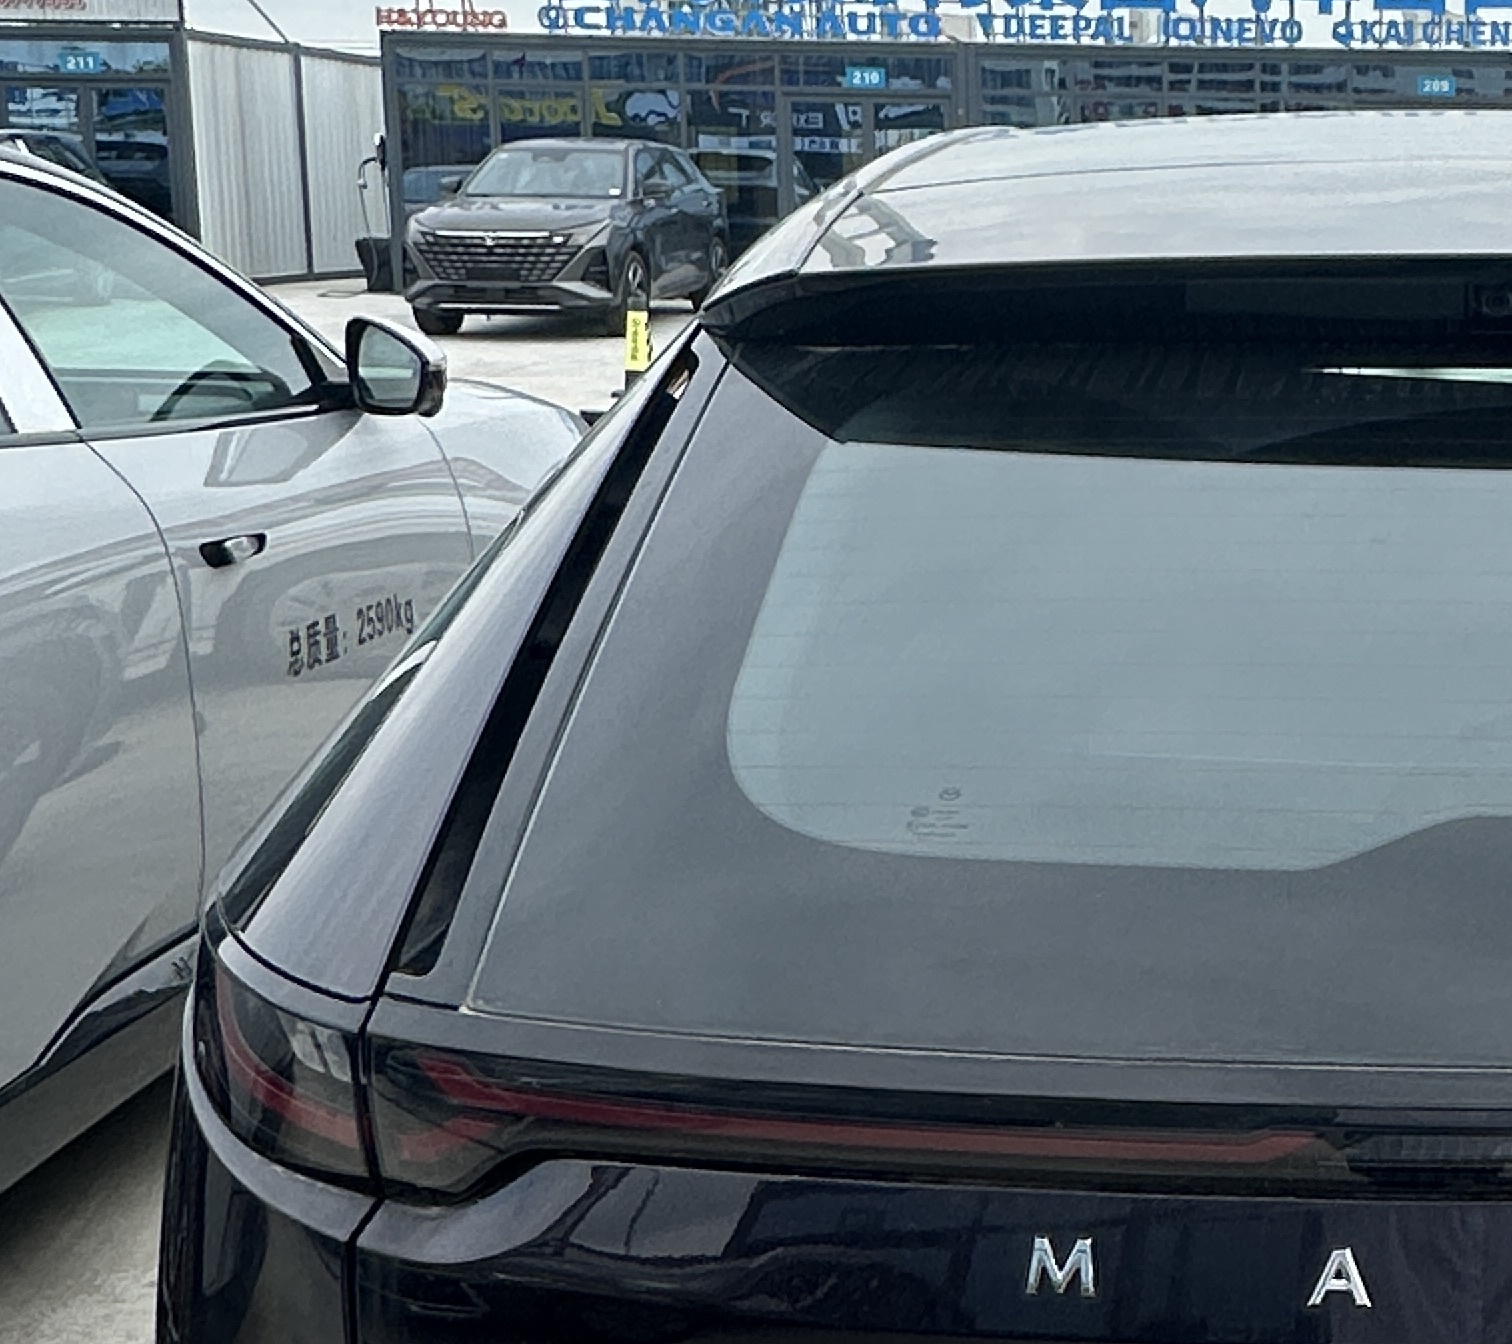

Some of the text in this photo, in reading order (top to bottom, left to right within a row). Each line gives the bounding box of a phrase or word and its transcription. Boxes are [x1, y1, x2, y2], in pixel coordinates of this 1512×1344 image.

[575, 6, 803, 38] CHANGAN
[816, 11, 941, 38] AUTO
[1003, 13, 1133, 42] DEEPAL
[66, 55, 95, 70] 211
[851, 70, 880, 85] 210
[356, 592, 414, 646] 2590kg
